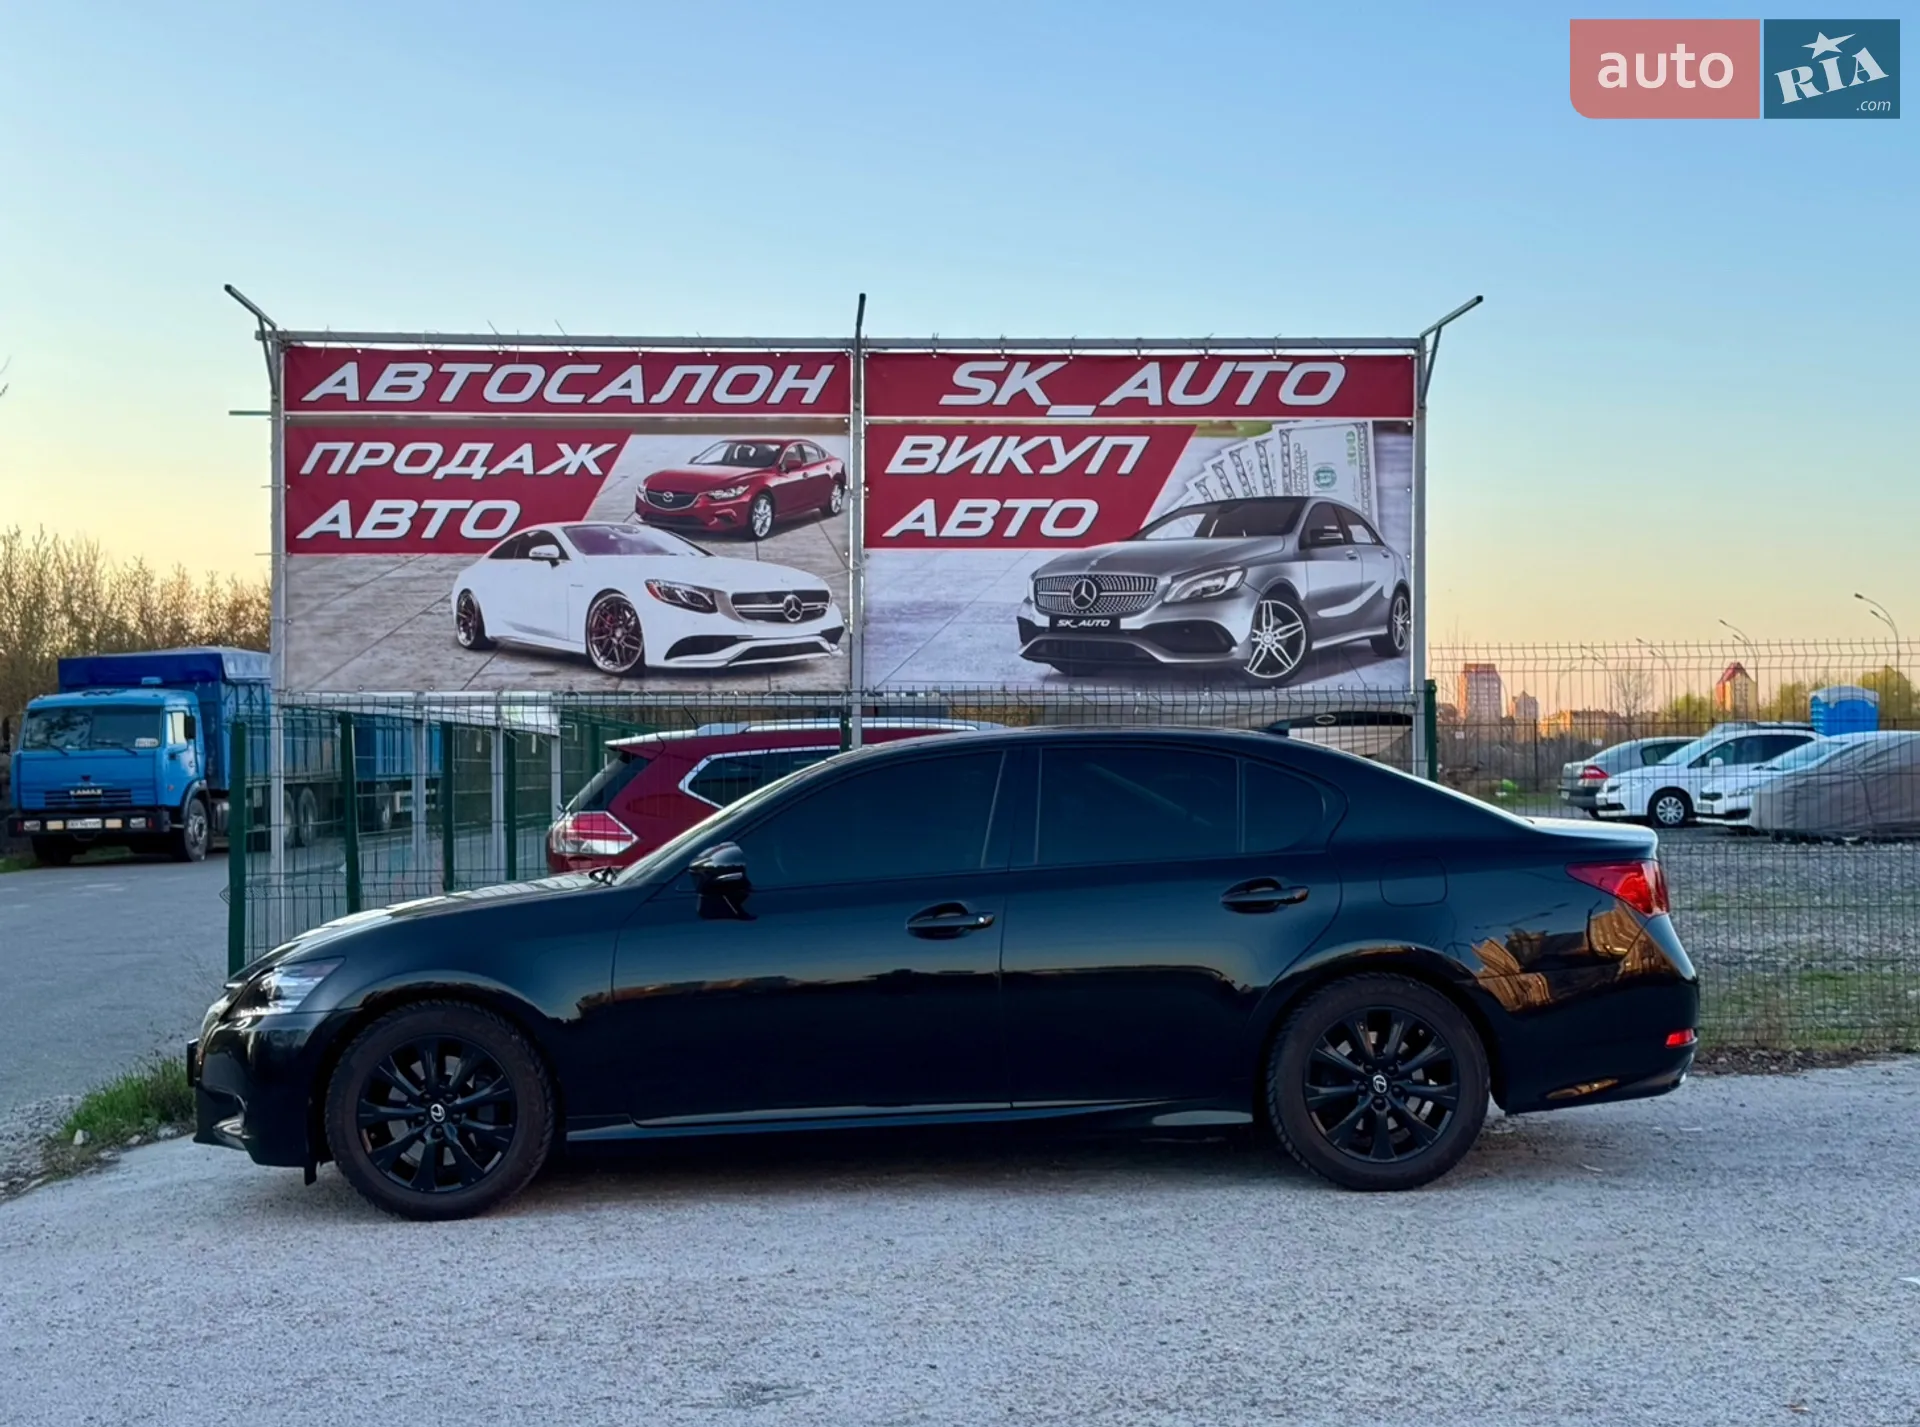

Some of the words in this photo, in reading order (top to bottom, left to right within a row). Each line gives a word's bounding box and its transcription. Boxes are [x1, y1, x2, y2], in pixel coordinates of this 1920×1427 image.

[301, 361, 836, 405] АВТОСАЛОН
[937, 360, 1348, 417] SK_AUTO
[299, 441, 619, 481] ПРОДАЖ
[884, 435, 1150, 475] ВИКУП
[296, 499, 521, 540] АВТО
[882, 498, 1099, 538] АВТО
[1056, 619, 1111, 629] SK_AUTO
